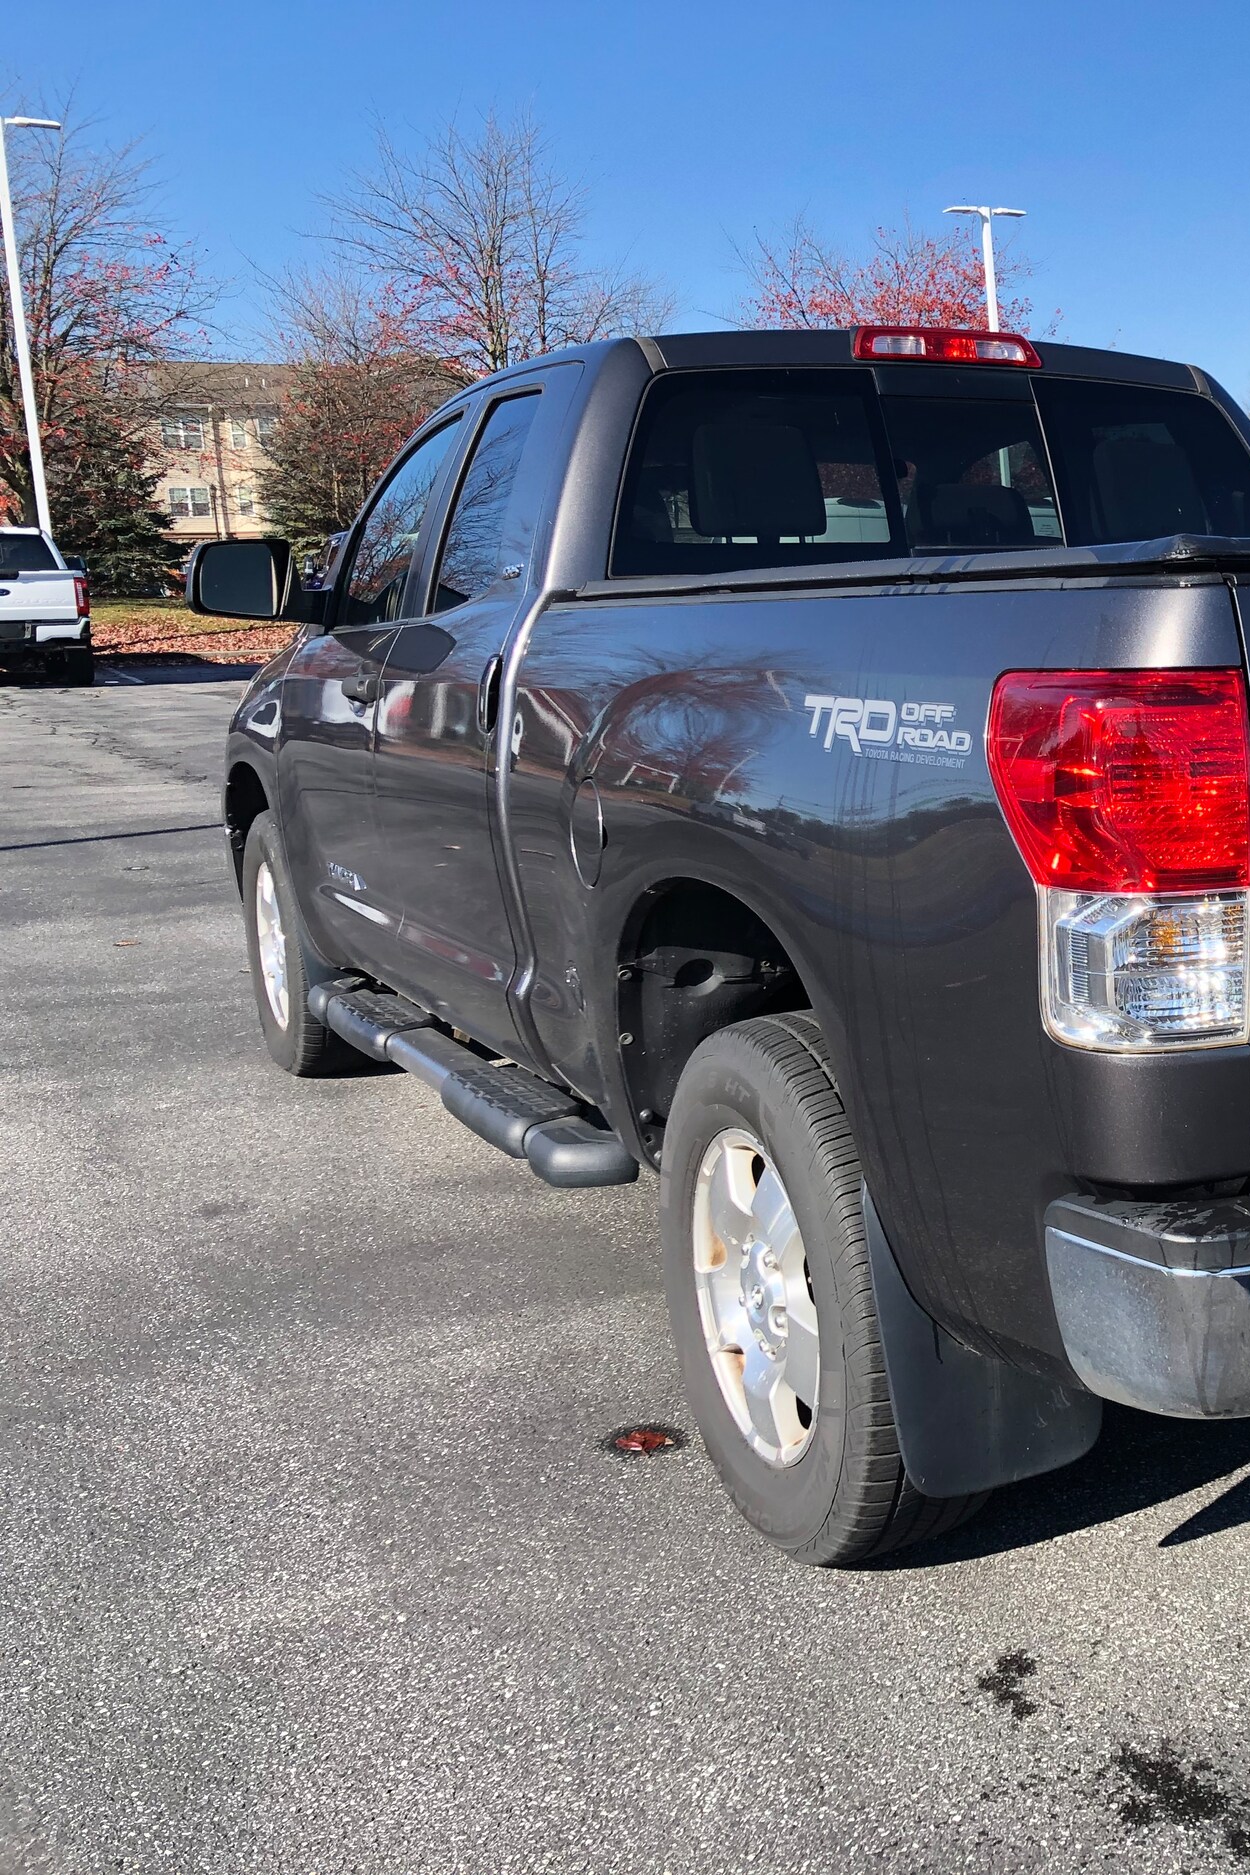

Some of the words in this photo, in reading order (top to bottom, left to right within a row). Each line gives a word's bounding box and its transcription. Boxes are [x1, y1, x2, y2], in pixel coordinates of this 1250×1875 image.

[804, 694, 897, 757] TRD
[901, 702, 957, 728] OFF
[896, 727, 972, 756] ROAD
[865, 748, 889, 760] TOYOTA
[890, 752, 915, 764] RACING
[916, 754, 966, 769] DEVELOPMENT
